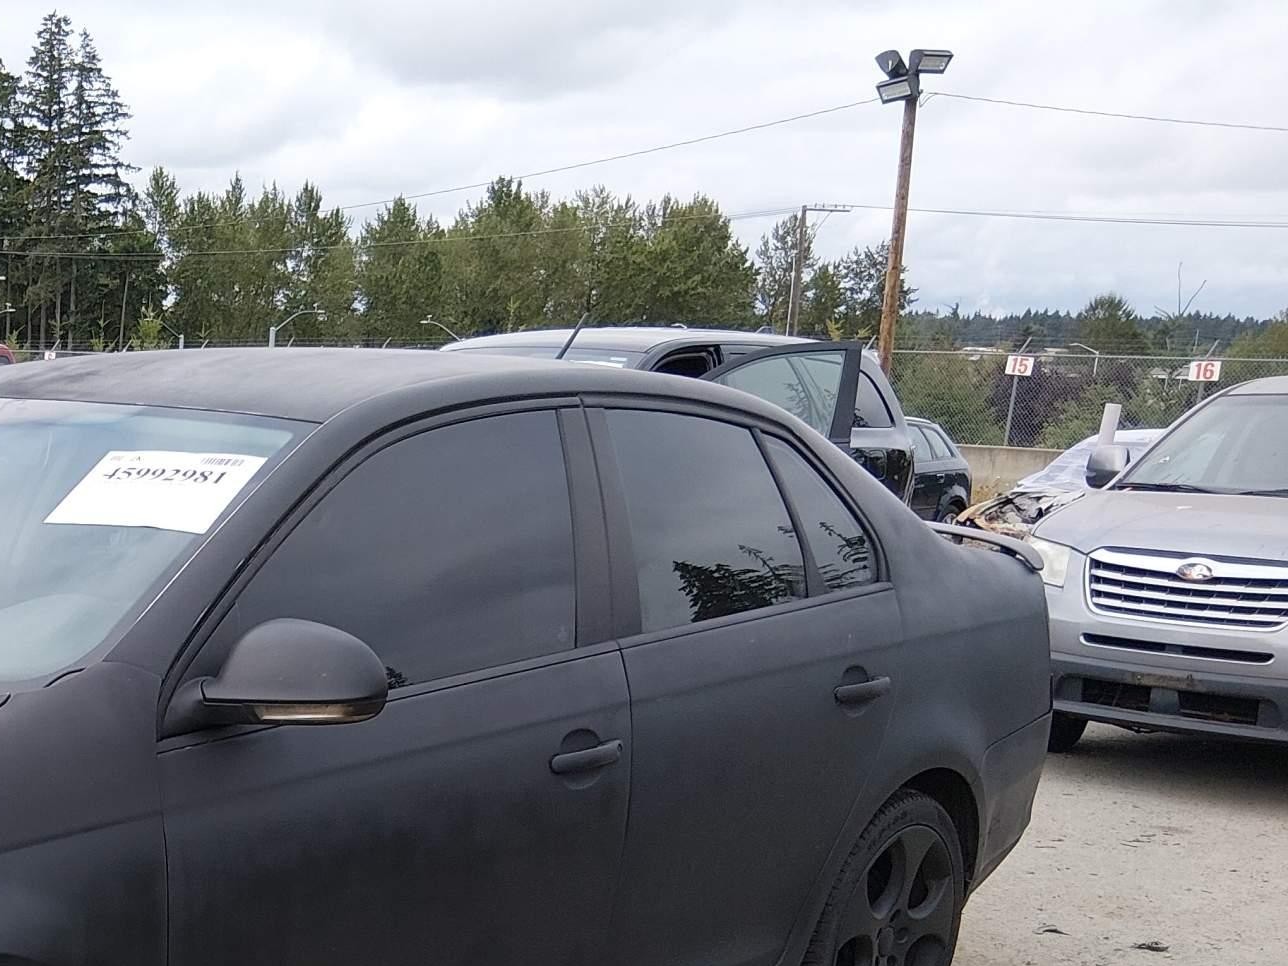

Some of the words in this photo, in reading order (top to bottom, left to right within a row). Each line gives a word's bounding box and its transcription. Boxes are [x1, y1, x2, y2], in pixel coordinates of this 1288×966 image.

[1012, 357, 1030, 375] 15
[1195, 362, 1215, 380] 16
[103, 466, 228, 485] 45992981
